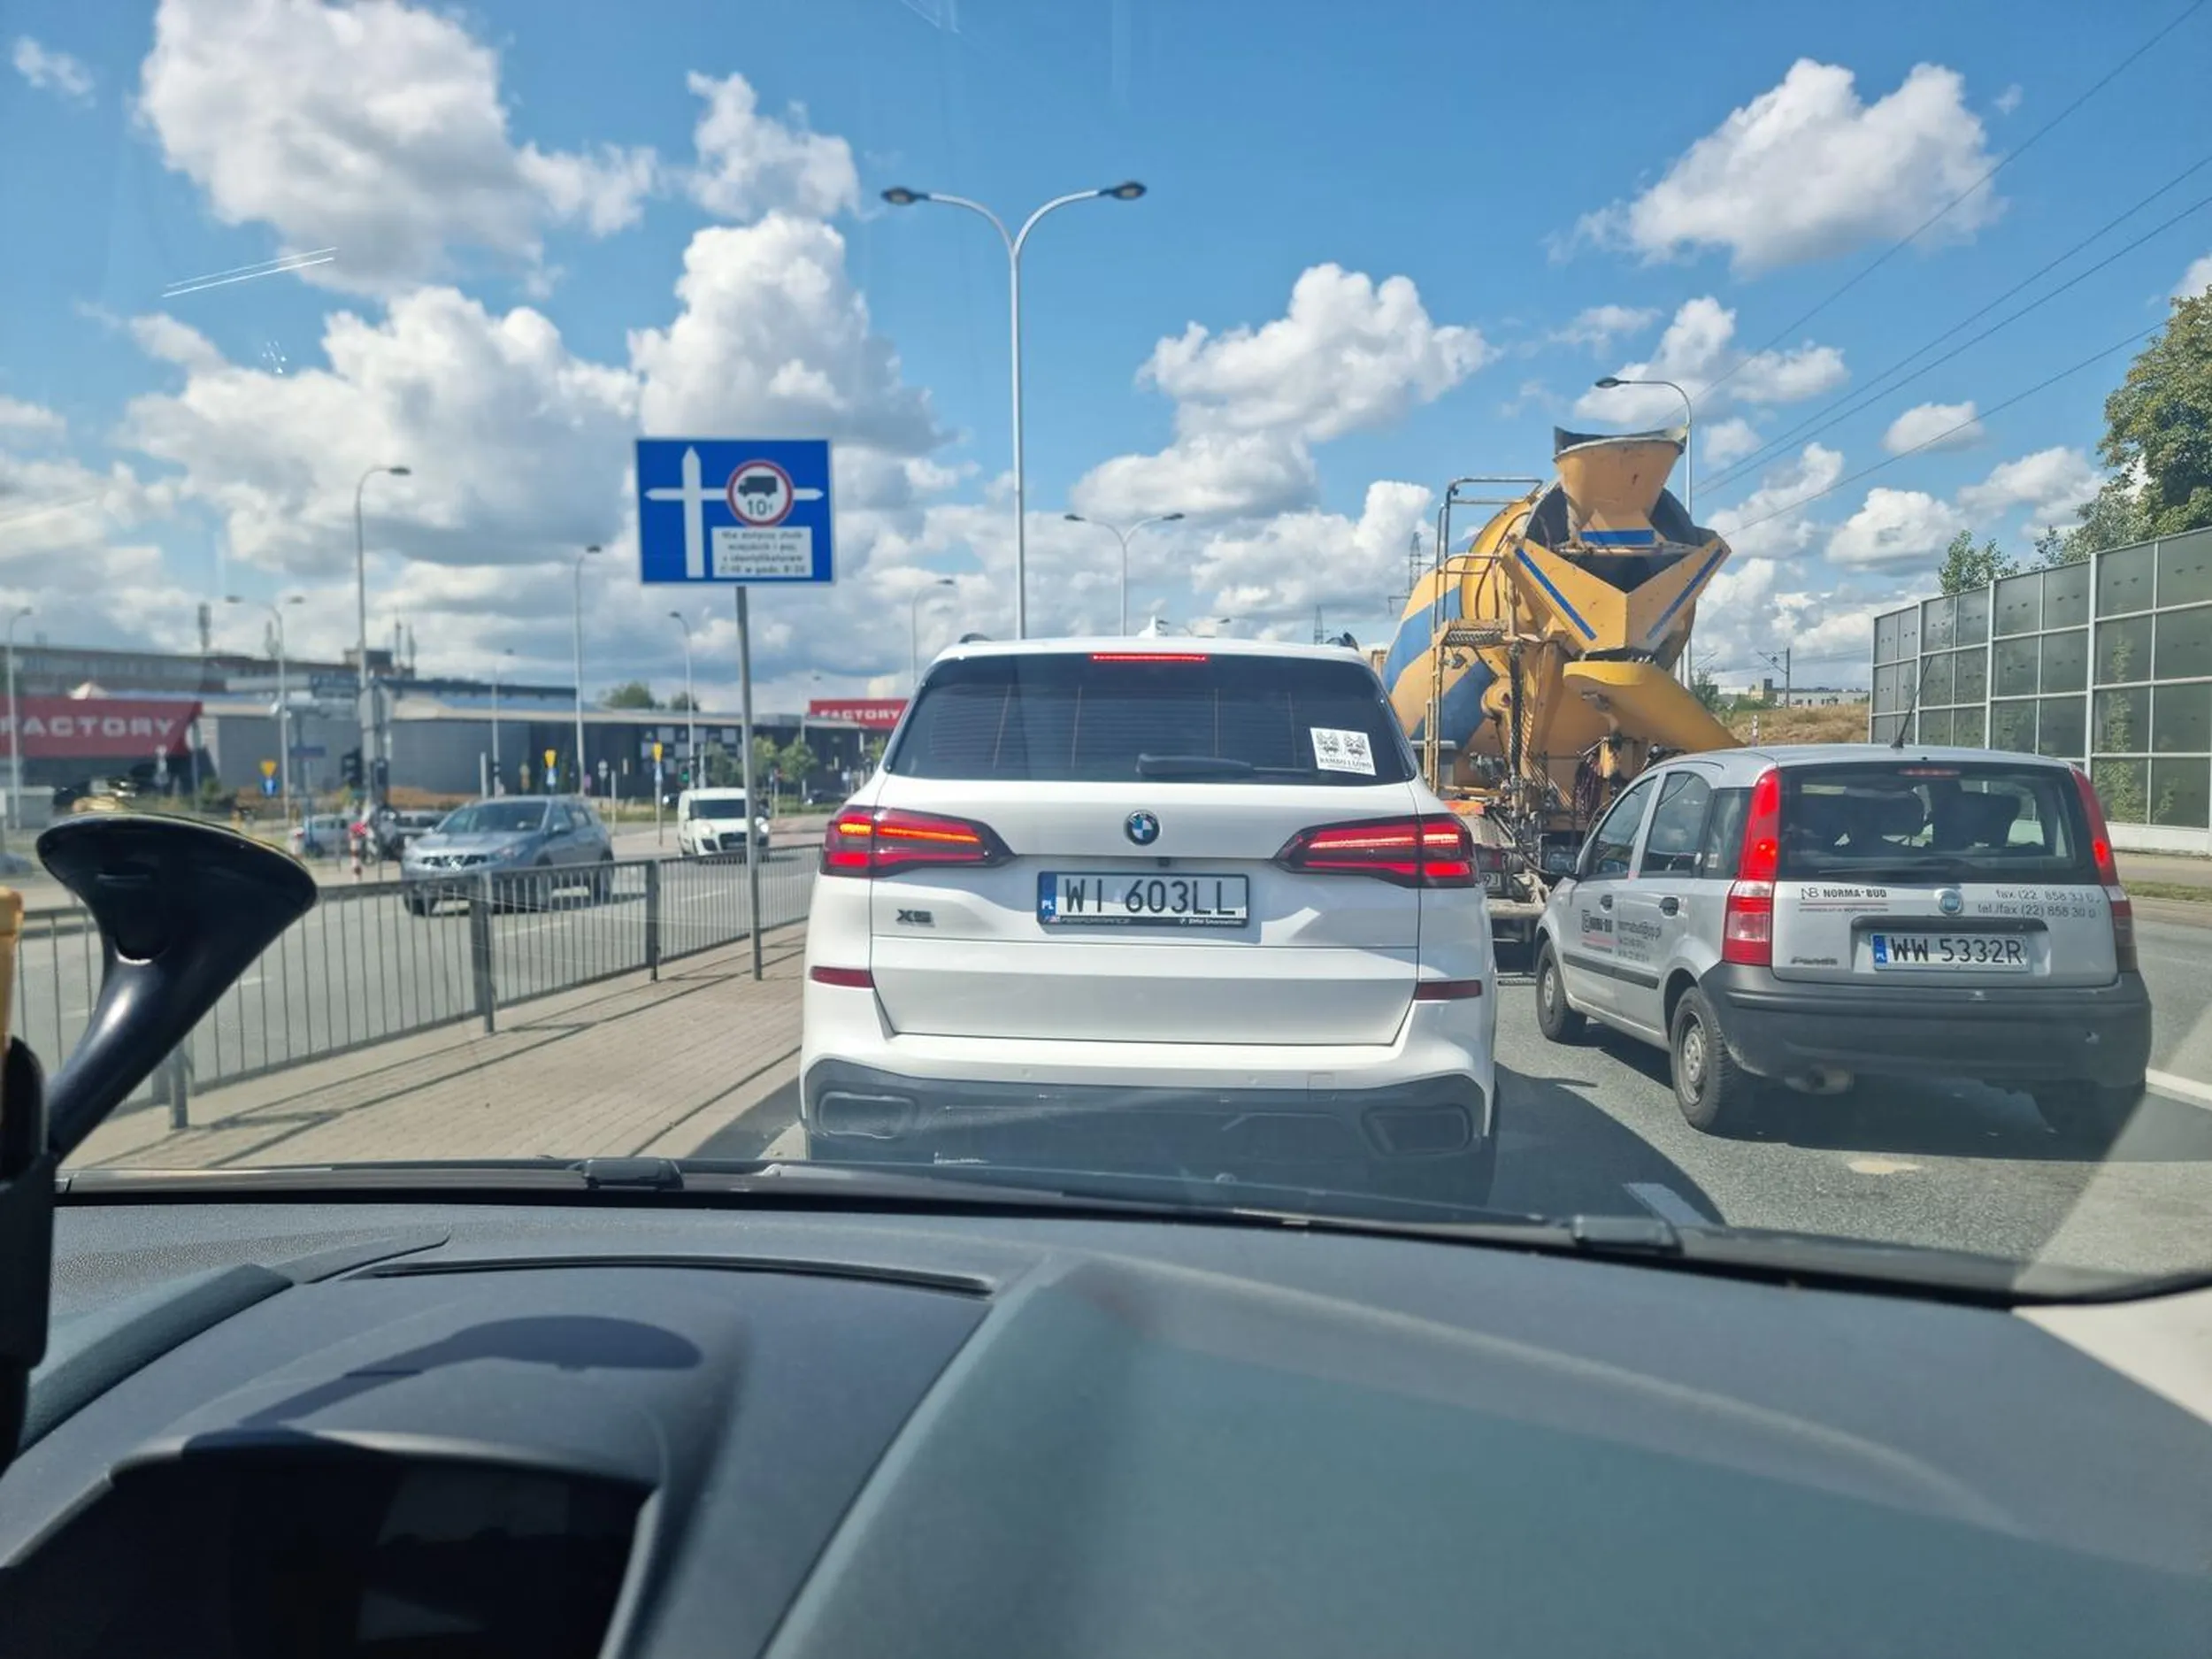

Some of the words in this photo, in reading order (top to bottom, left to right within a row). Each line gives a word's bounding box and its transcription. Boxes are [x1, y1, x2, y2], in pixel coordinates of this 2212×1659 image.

[1041, 901, 1054, 910] PL
[1065, 879, 1102, 912] WI
[1125, 879, 1236, 915] 603LL
[1891, 938, 1928, 962] WW
[1939, 938, 2023, 964] 5332R
